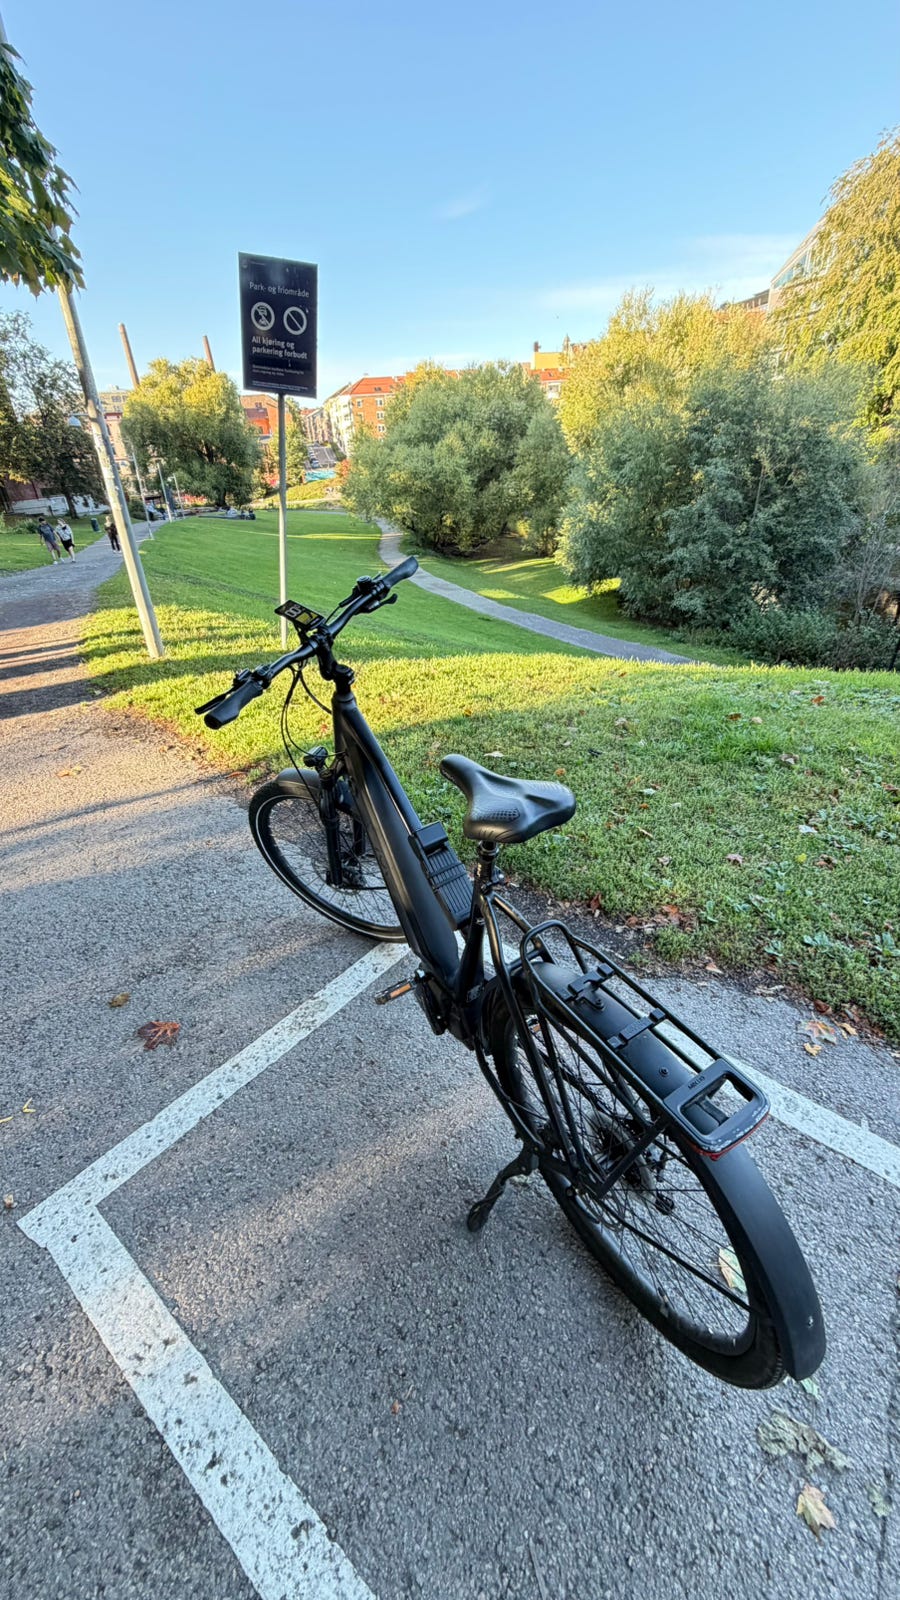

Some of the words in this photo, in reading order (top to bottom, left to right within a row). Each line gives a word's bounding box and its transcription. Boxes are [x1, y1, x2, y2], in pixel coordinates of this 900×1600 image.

[249, 281, 266, 291] Park-
[267, 286, 277, 294] og
[277, 286, 310, 298] friområde
[252, 336, 261, 344] All
[262, 337, 285, 349] kjøring
[286, 341, 295, 350] og
[252, 346, 283, 358] parkering
[284, 349, 307, 359] forbudt
